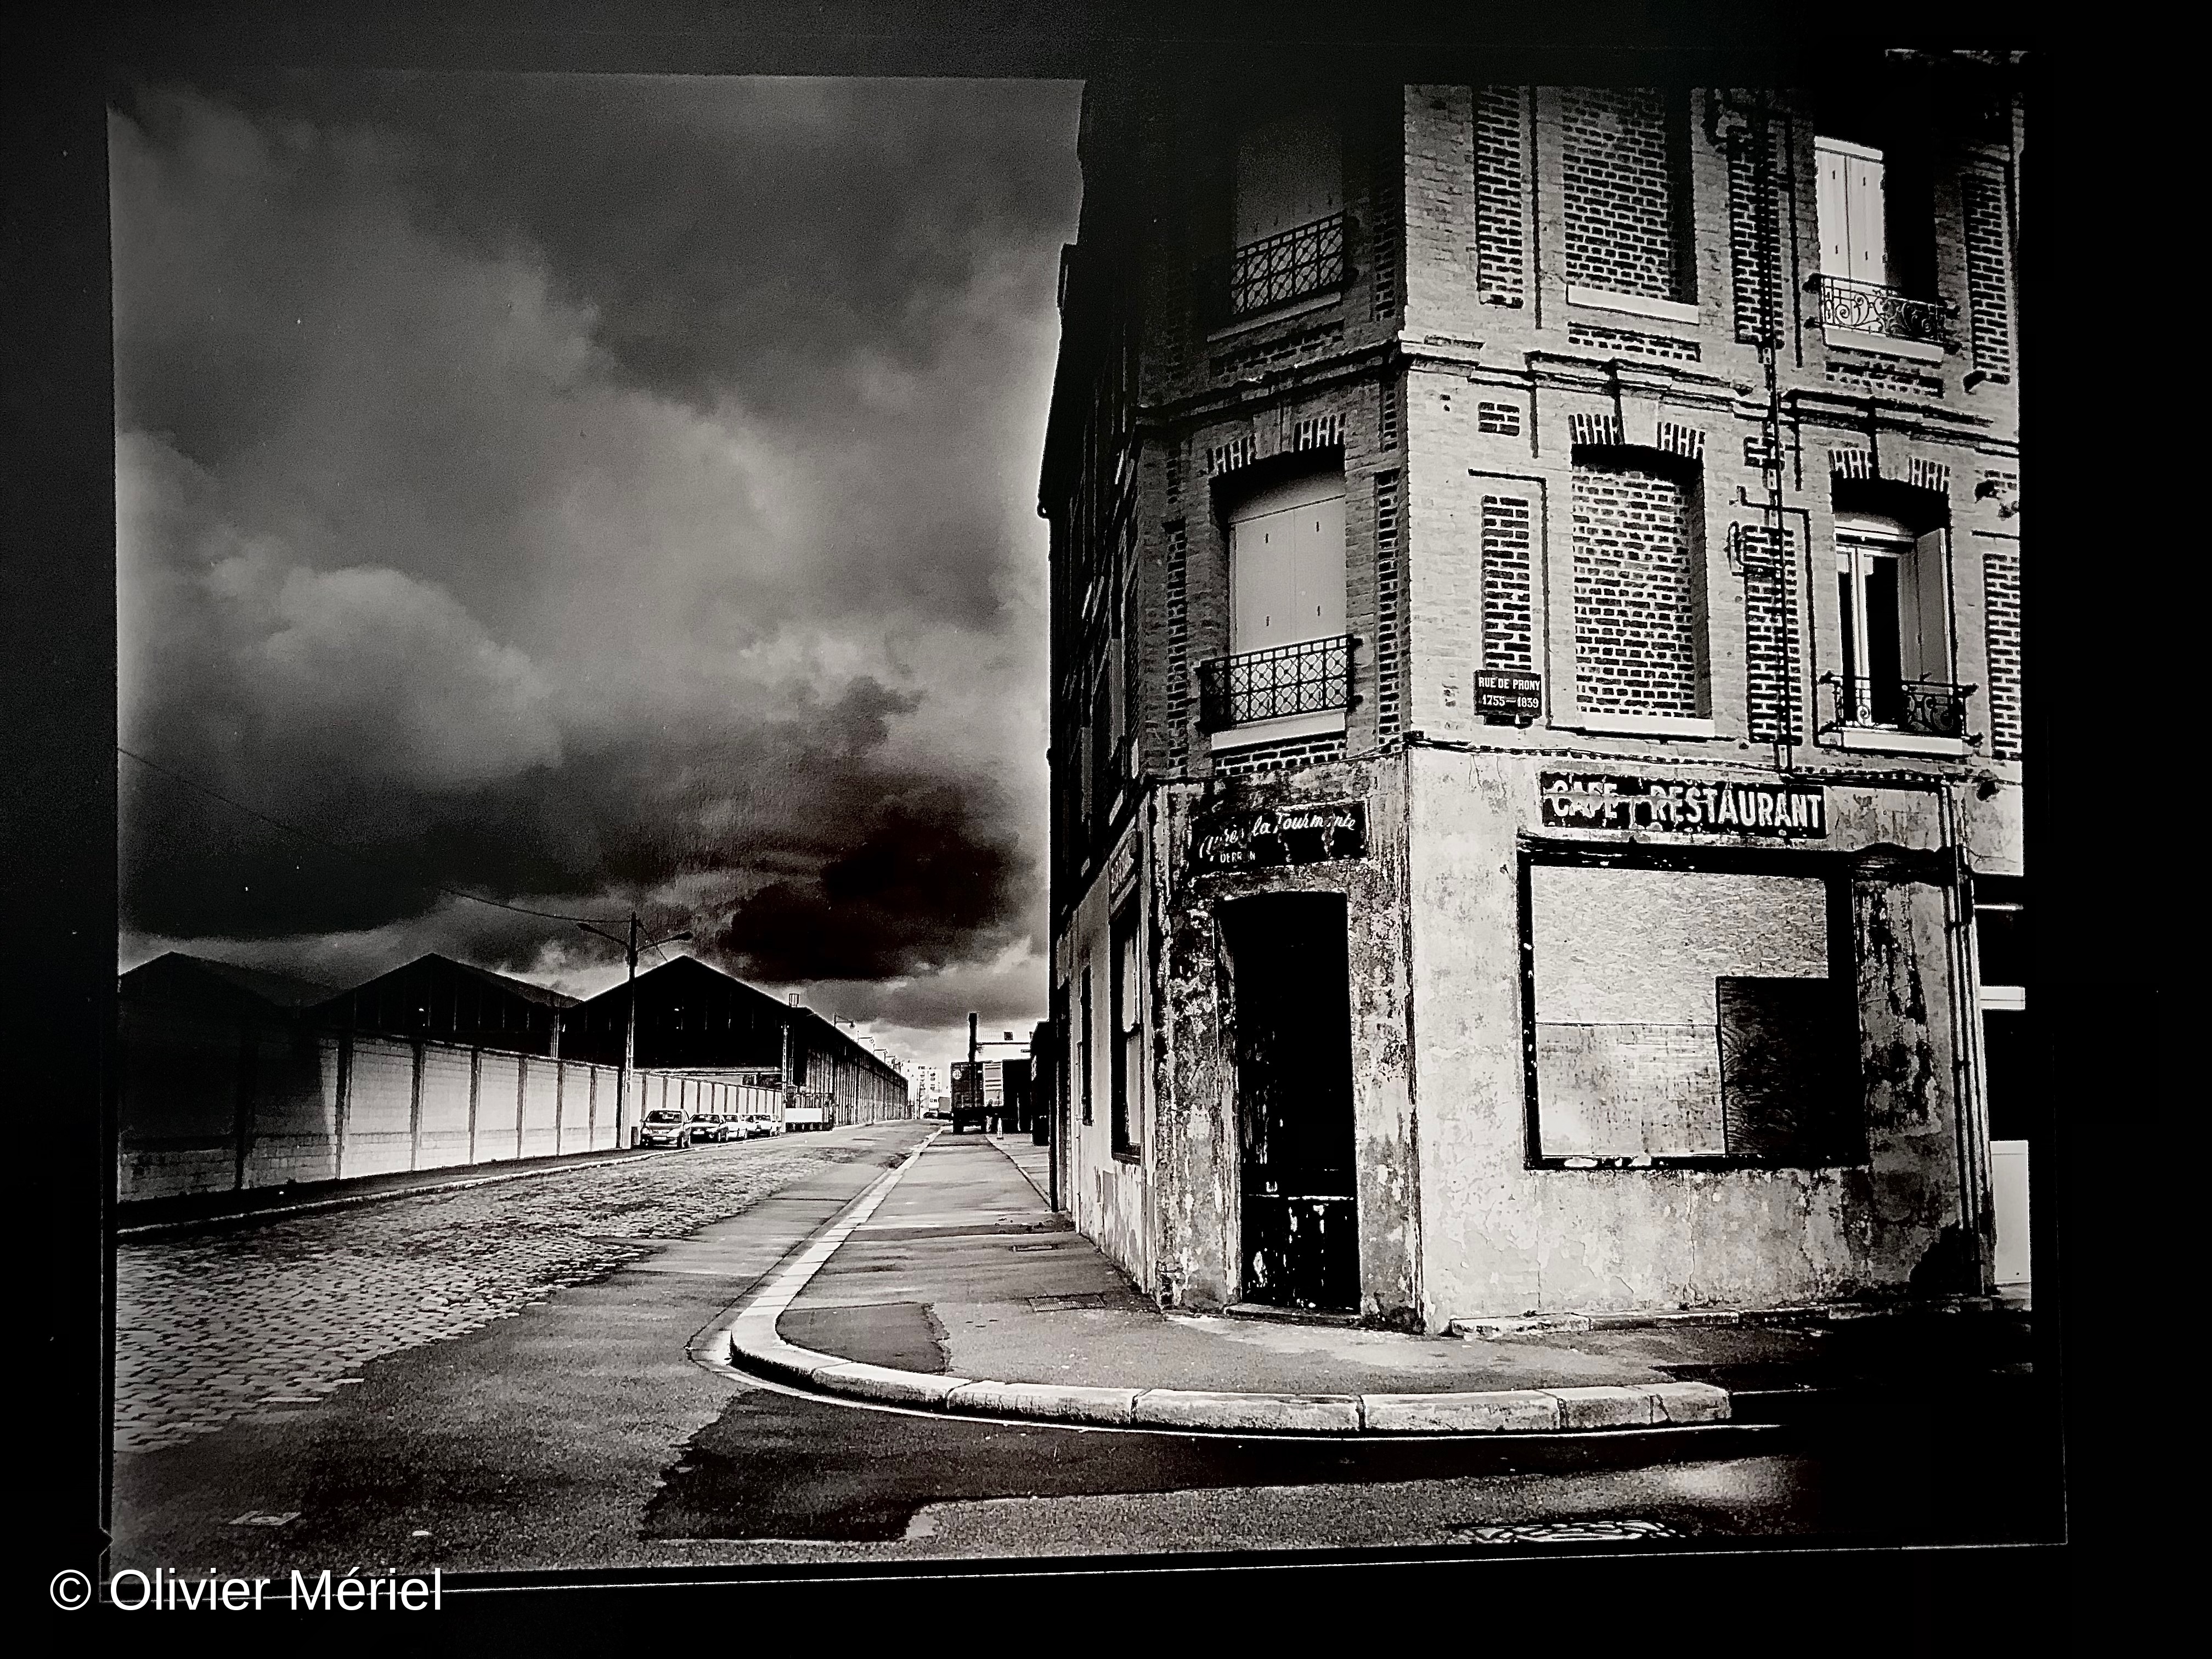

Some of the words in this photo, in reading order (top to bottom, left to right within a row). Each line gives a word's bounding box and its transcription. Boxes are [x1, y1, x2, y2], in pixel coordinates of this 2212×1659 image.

[1479, 677, 1497, 688] RUE
[1498, 678, 1509, 689] DE
[1513, 679, 1541, 691] PRONY
[1649, 785, 1822, 828] RESTAURANT
[1251, 815, 1271, 837] la
[1272, 812, 1356, 834] Tourmnte
[1220, 850, 1256, 864] DERRN
